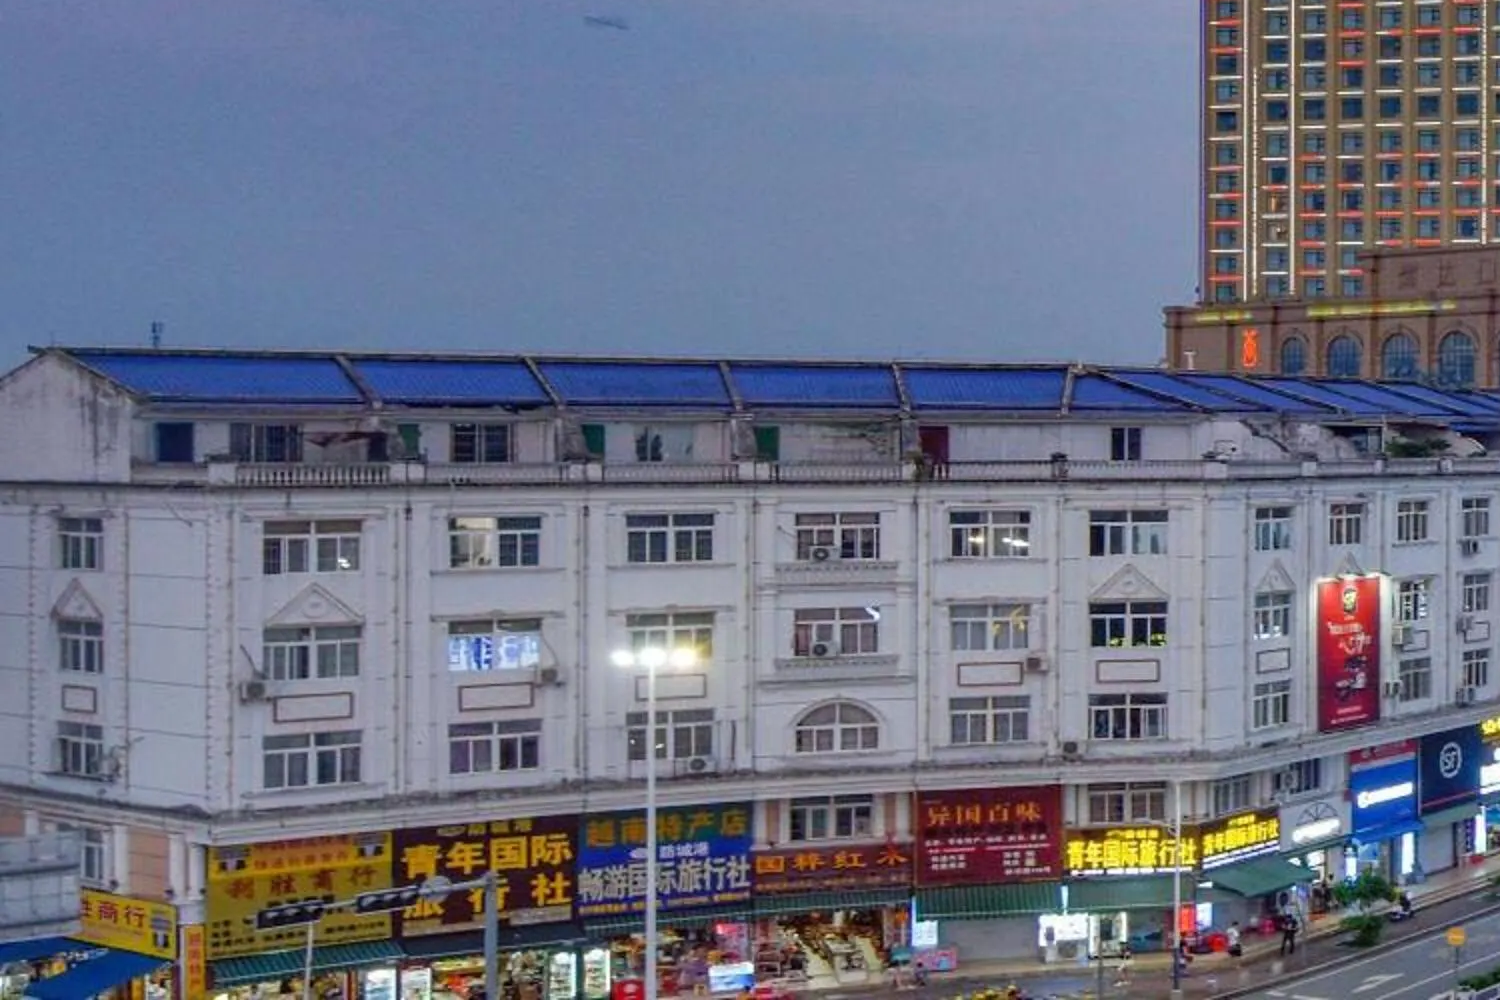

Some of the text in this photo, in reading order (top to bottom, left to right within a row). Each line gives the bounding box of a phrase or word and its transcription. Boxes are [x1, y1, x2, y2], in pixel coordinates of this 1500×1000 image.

[586, 809, 747, 846] 越南特产店
[402, 833, 572, 879] 青年国际
[1067, 838, 1197, 869] 青年国际旅行社
[578, 854, 752, 904] 畅游国际旅行社
